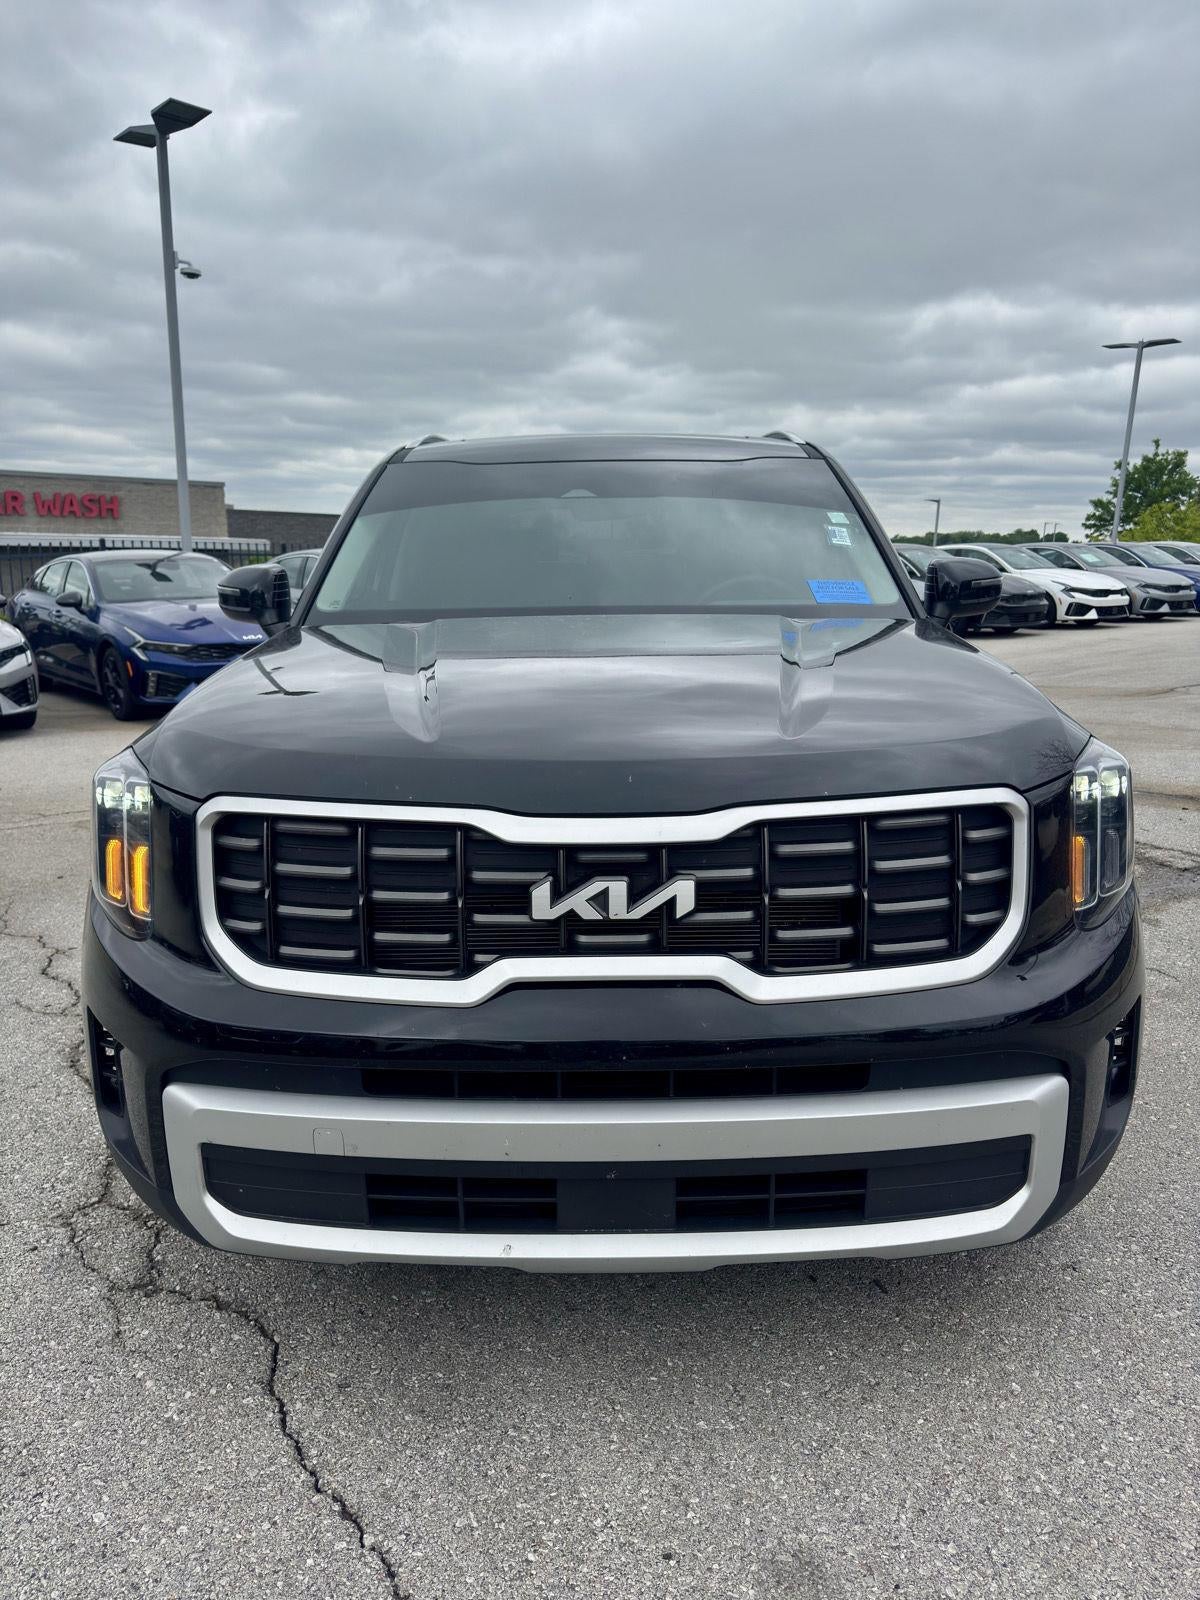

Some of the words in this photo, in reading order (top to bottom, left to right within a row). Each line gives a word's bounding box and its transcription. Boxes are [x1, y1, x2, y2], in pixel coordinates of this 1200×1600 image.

[0, 490, 26, 516] R
[33, 491, 119, 519] WASH
[530, 875, 697, 921] KIA
